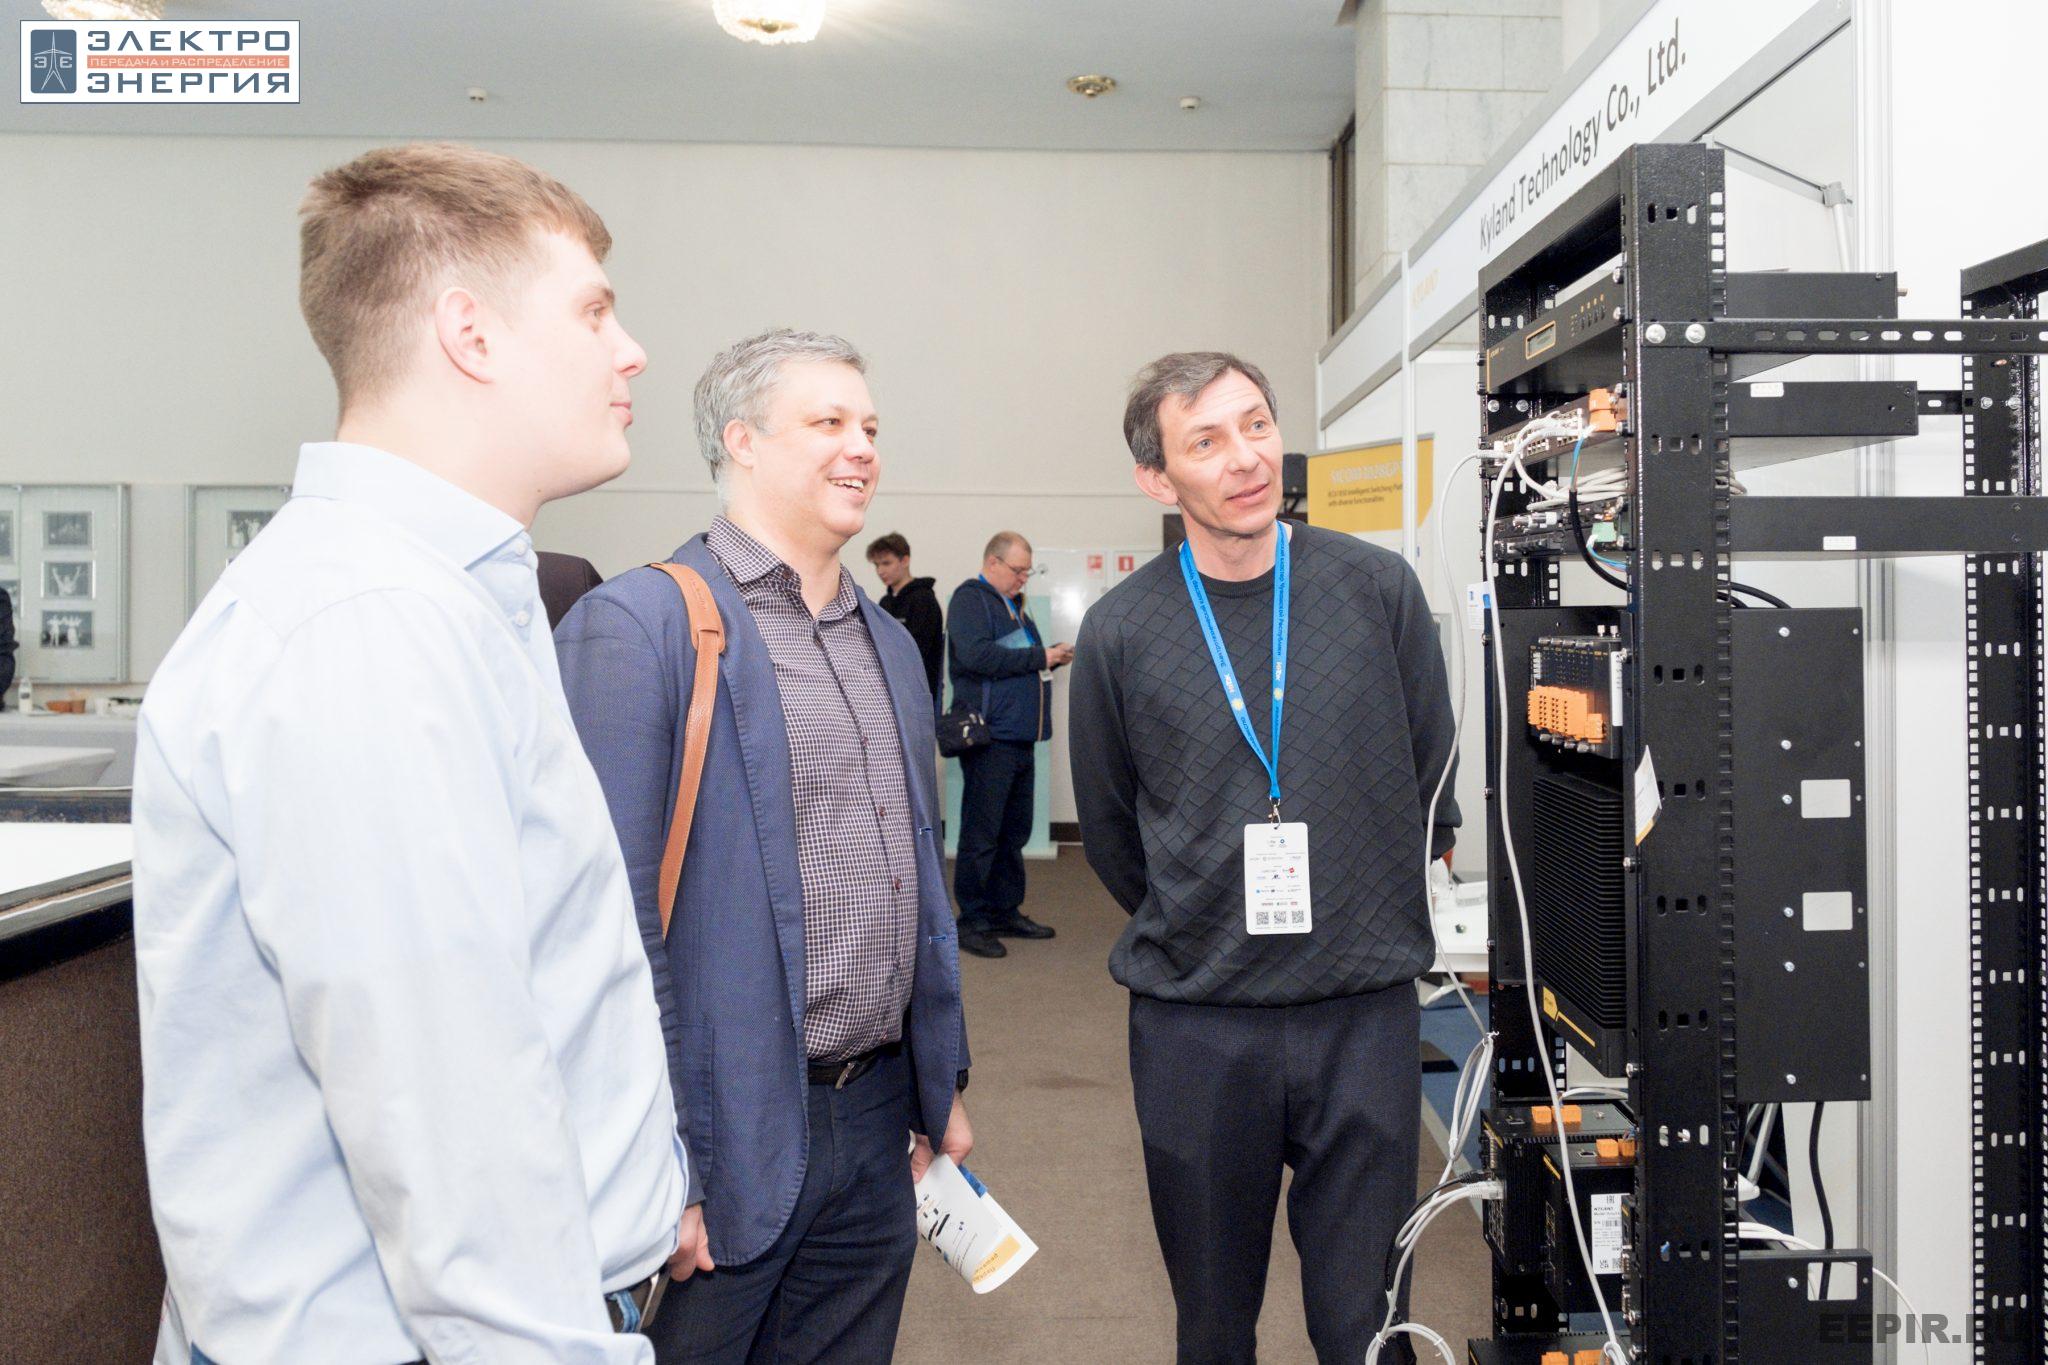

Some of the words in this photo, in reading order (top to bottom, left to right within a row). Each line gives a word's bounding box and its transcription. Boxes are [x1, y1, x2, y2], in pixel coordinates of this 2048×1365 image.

[1480, 181, 1516, 251] Kyland
[1519, 110, 1601, 212] Technology
[1606, 83, 1640, 131] Co.,
[1647, 17, 1686, 96] Ltd.
